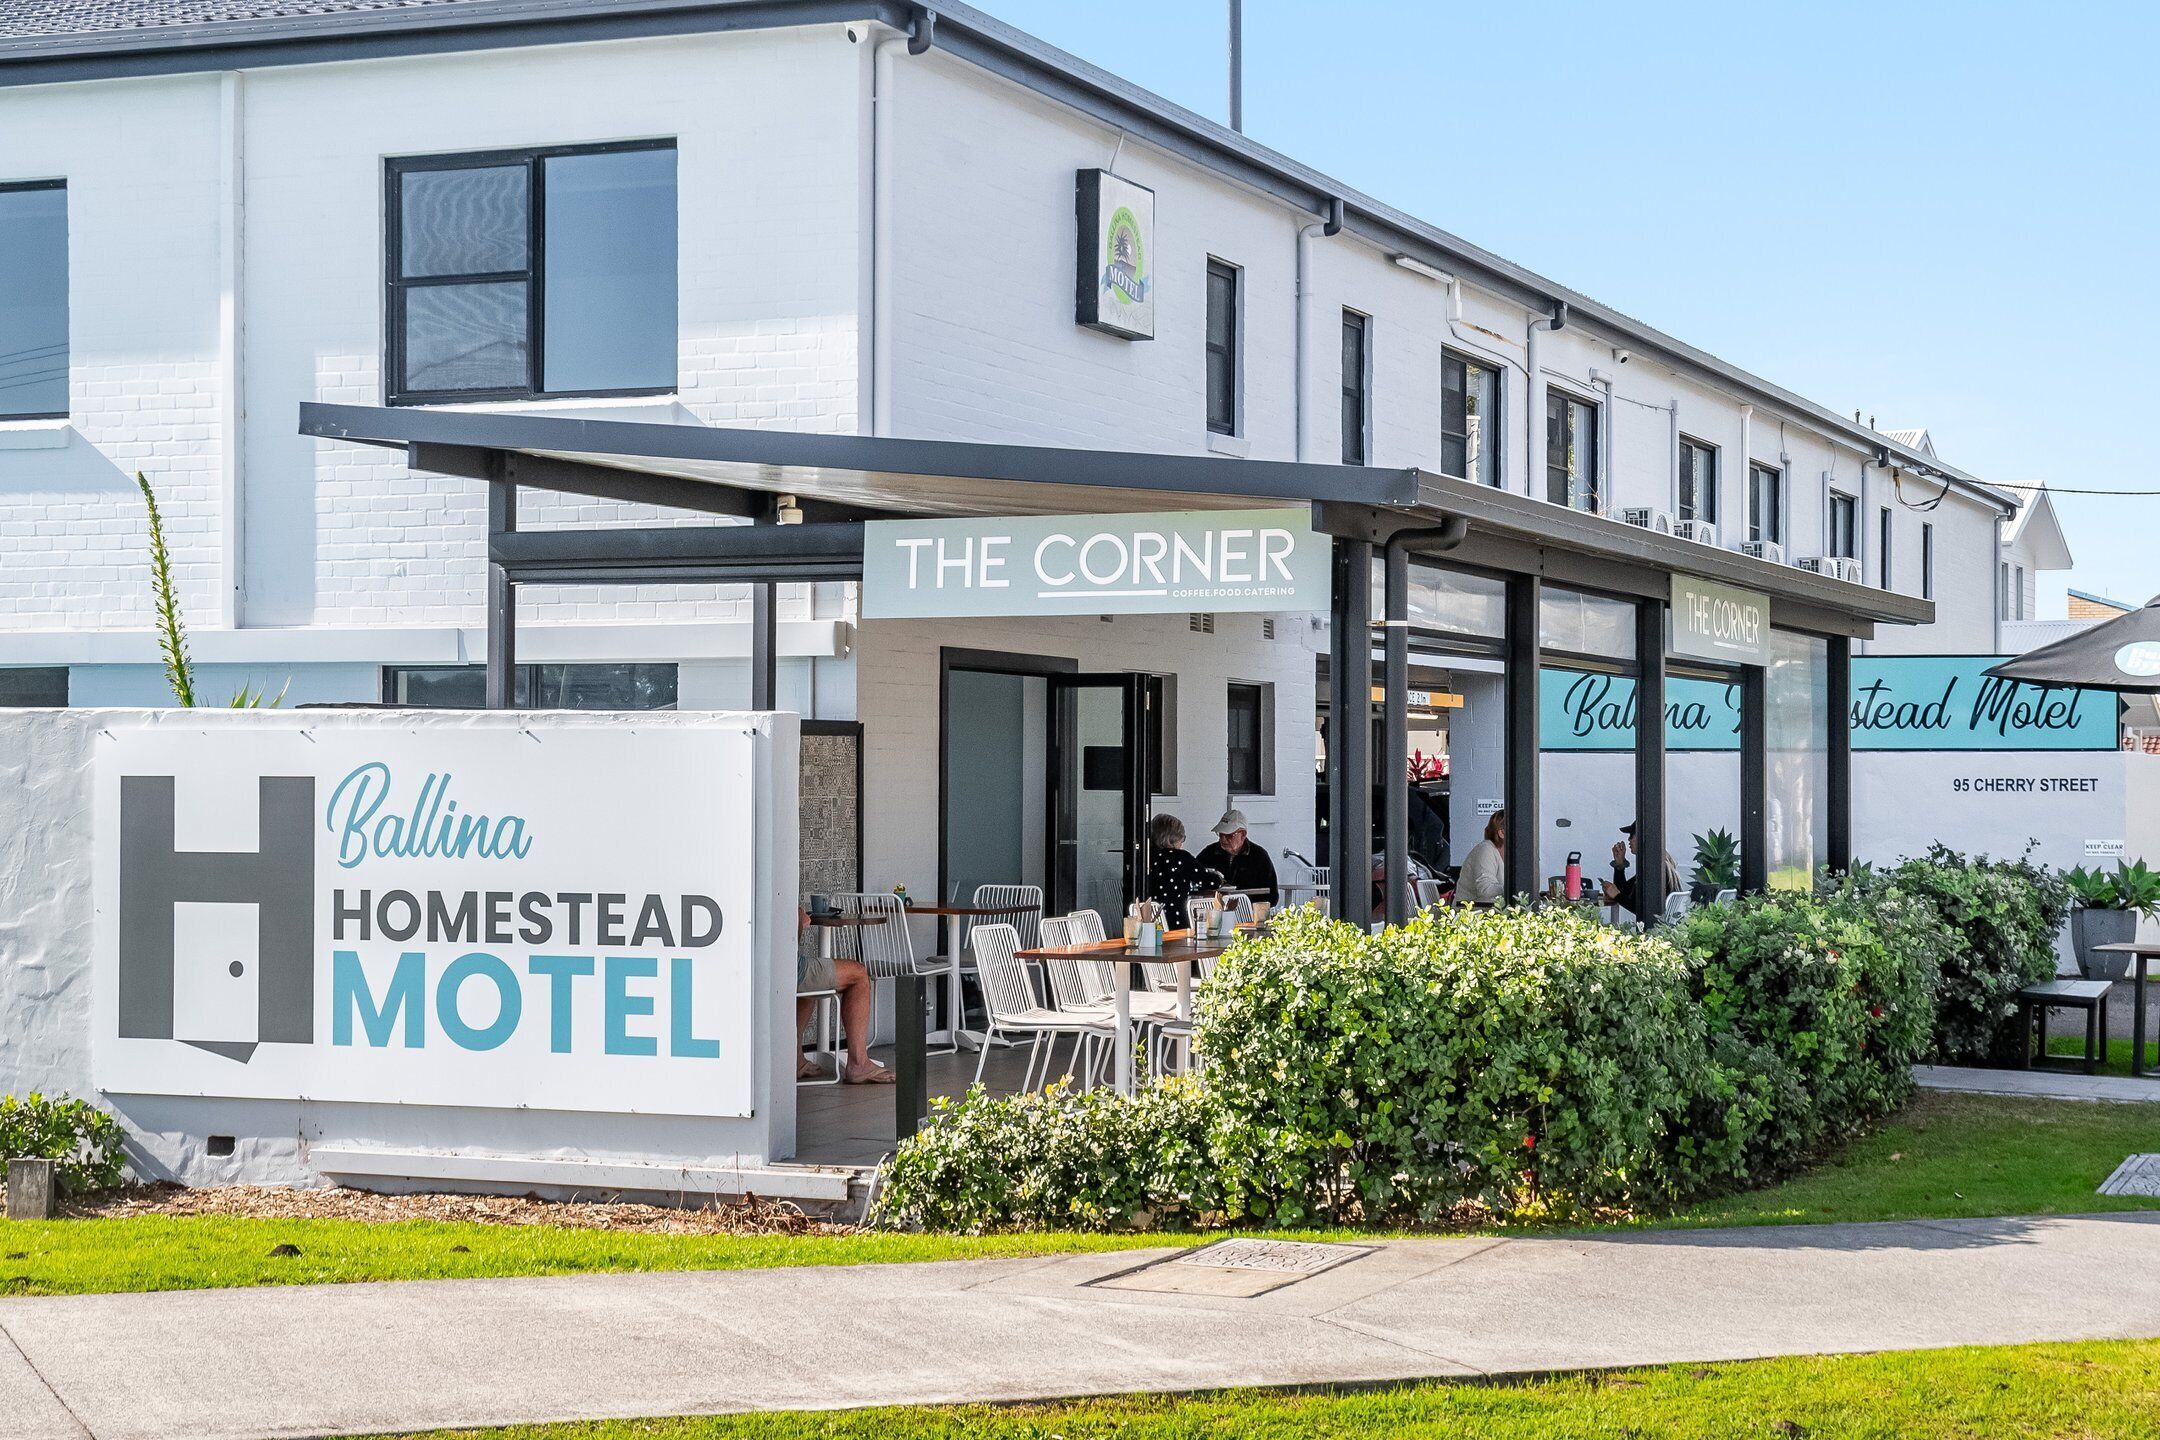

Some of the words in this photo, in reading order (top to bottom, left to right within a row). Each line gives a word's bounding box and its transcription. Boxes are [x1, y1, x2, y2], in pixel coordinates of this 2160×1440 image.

[1109, 265, 1140, 301] MOTEL
[895, 536, 1011, 589] THE
[1033, 528, 1295, 586] CORNER
[1685, 591, 1710, 635] THE
[1712, 598, 1760, 644] CORNER
[1563, 673, 1711, 737] Balna
[1969, 676, 2082, 737] Motel
[1953, 779, 1970, 792] 95
[1974, 779, 2036, 792] CHERRY
[2040, 778, 2099, 792] STREET
[326, 762, 533, 869] Ballina
[332, 889, 723, 948] HOMESTEAD
[332, 950, 721, 1059] MOTEL
